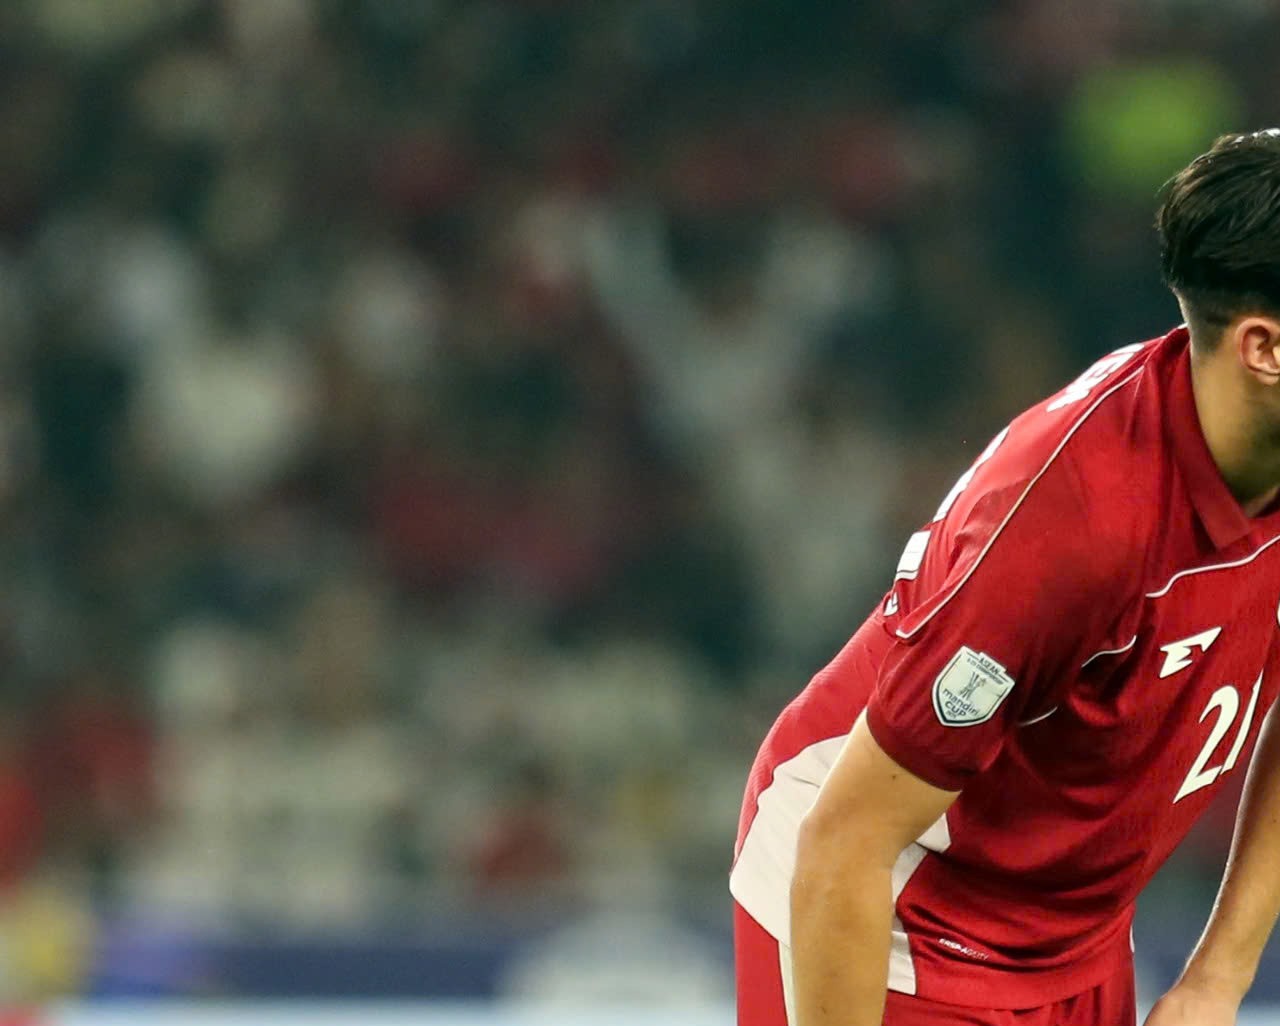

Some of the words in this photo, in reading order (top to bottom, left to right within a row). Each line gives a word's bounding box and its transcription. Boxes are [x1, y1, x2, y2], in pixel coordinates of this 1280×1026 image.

[979, 657, 1001, 675] ASEAN
[944, 700, 967, 717] CUP
[1173, 668, 1264, 804] 21
